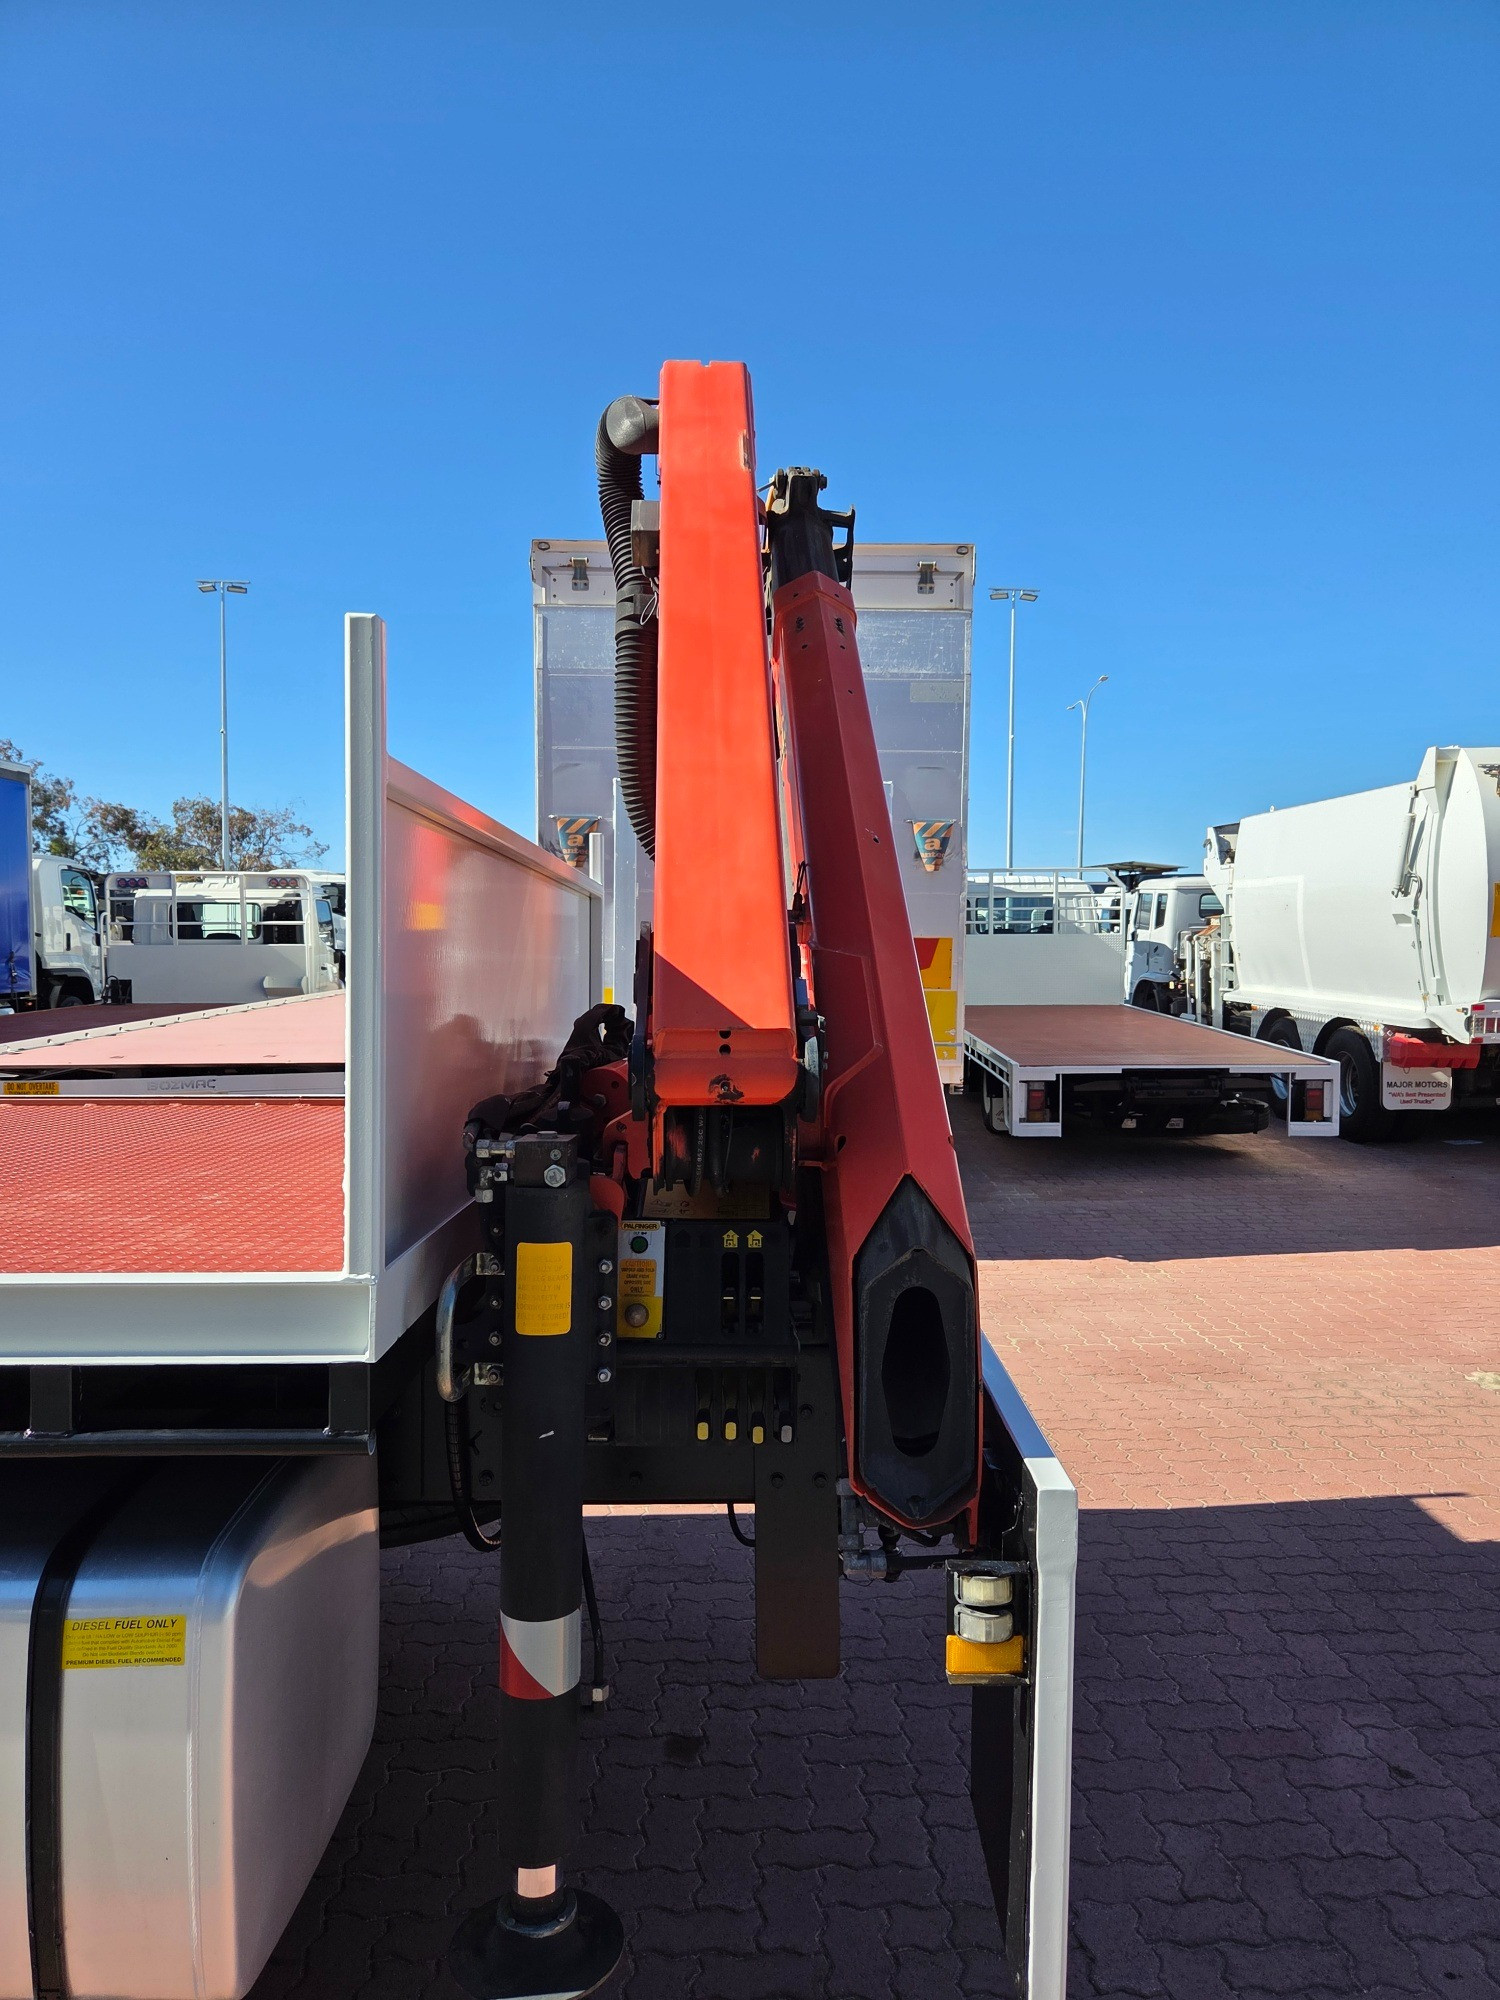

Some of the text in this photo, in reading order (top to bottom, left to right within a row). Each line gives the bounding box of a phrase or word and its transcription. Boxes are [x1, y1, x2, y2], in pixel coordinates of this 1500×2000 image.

[6, 1082, 56, 1090] DO NOT OVERTAKE
[72, 1618, 178, 1631] DIESEL FUEL ONLY
